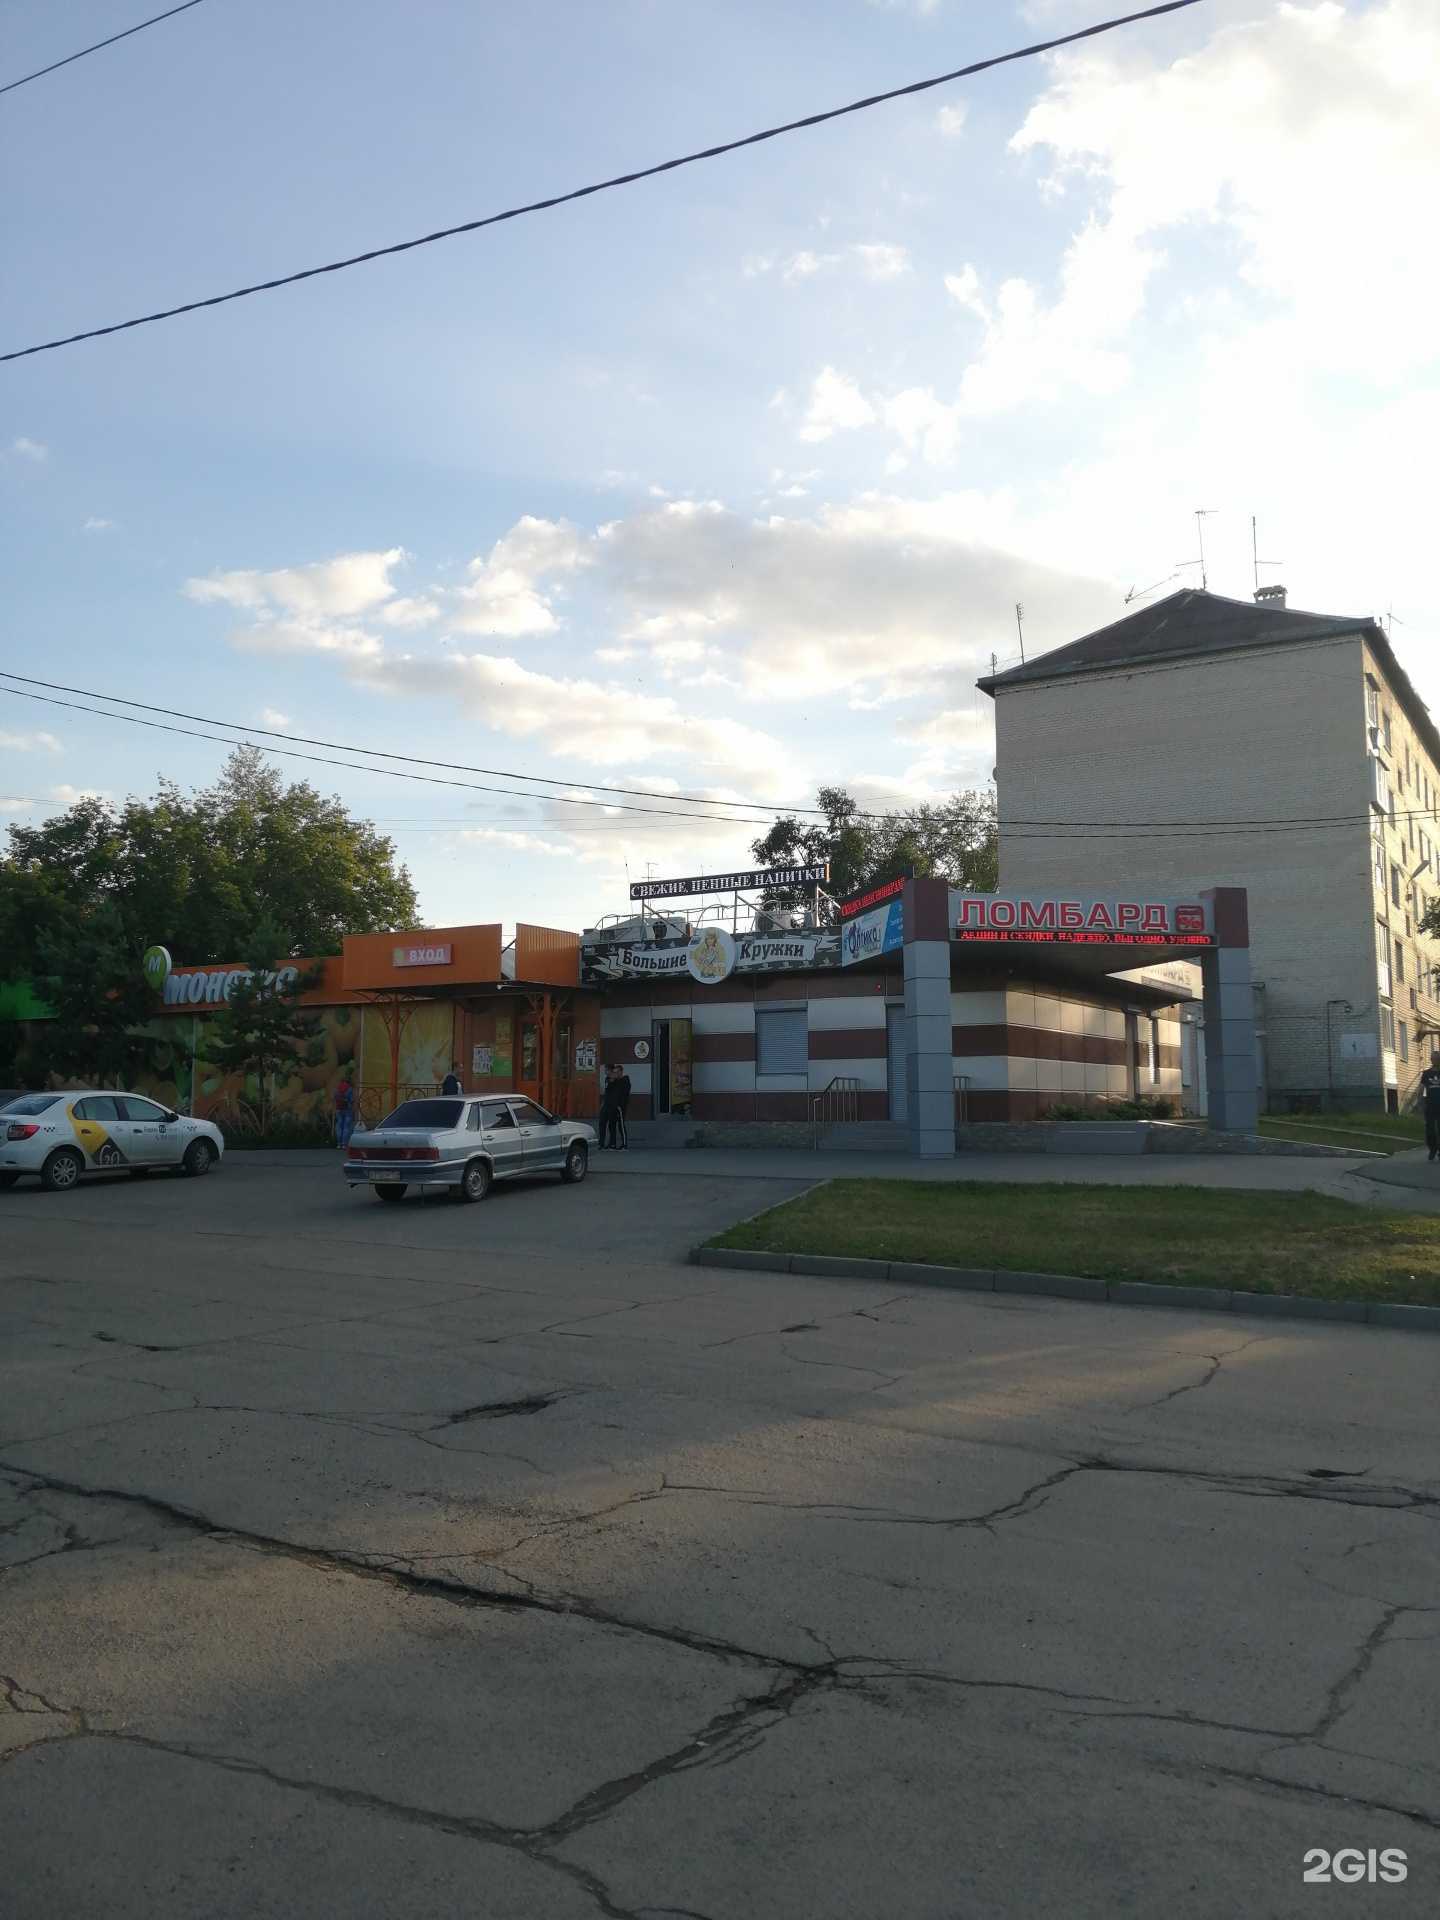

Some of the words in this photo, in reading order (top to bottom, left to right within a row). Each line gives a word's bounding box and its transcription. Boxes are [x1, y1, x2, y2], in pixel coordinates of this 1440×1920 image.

[755, 866, 825, 886] НАПИТКИ
[958, 899, 1169, 932] ЛОМБАРД
[409, 947, 445, 963] ВХОД
[621, 950, 687, 970] Большие
[739, 941, 804, 961] Кружки
